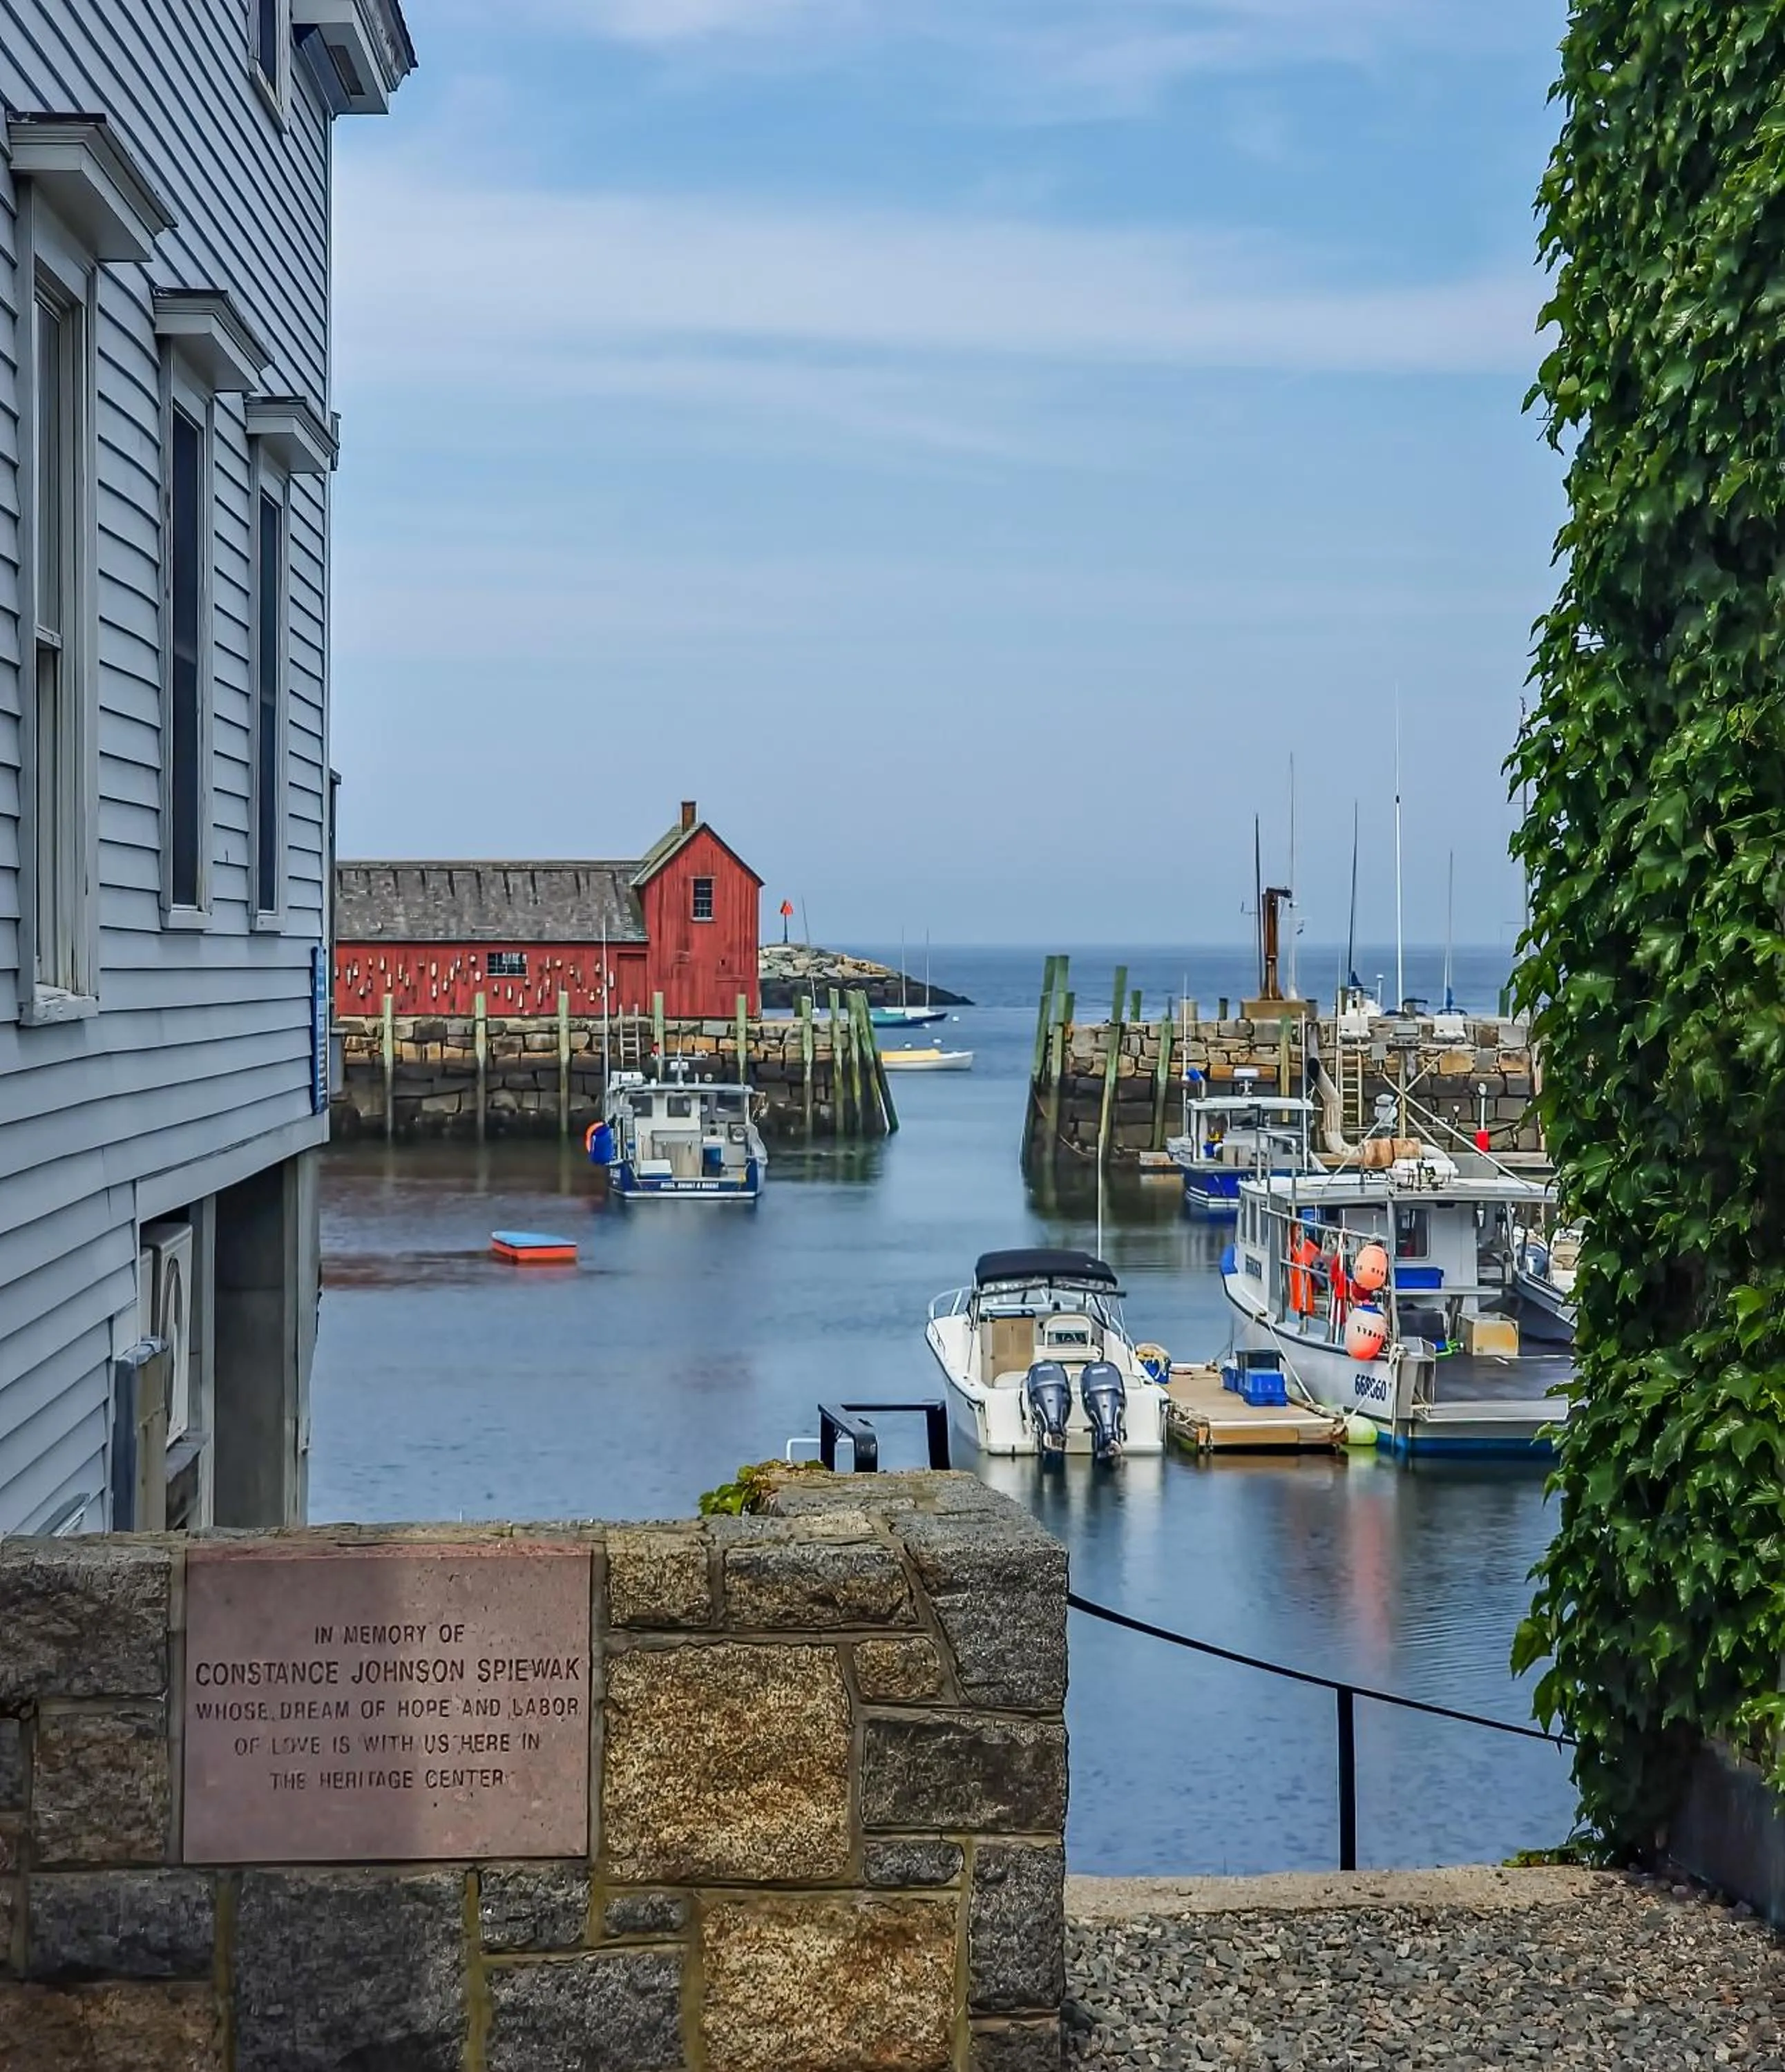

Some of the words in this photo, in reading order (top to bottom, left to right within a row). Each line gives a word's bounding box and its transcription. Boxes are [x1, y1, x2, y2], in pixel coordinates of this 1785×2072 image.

[314, 1626, 333, 1644] IN
[344, 1625, 427, 1645] MEMORY
[439, 1624, 465, 1644] OF
[195, 1660, 339, 1687] CONSTANCE
[351, 1659, 464, 1684] JOHNSON
[477, 1658, 580, 1683] SPIEWAK
[196, 1701, 268, 1721] WHOSE
[280, 1701, 349, 1720] DREAM
[361, 1700, 385, 1720] OF
[397, 1699, 450, 1718] HOPE
[462, 1698, 501, 1717] AND
[513, 1697, 579, 1717] LABOR
[234, 1737, 260, 1756] OF
[271, 1736, 321, 1755] LOVE
[333, 1735, 350, 1754] IS
[363, 1734, 413, 1752] WITH
[425, 1734, 449, 1754] US
[461, 1733, 510, 1752] HERE
[522, 1732, 540, 1750] IN
[270, 1772, 305, 1790] THE
[320, 1769, 414, 1789] HERITAGE
[425, 1768, 504, 1789] CENTER
